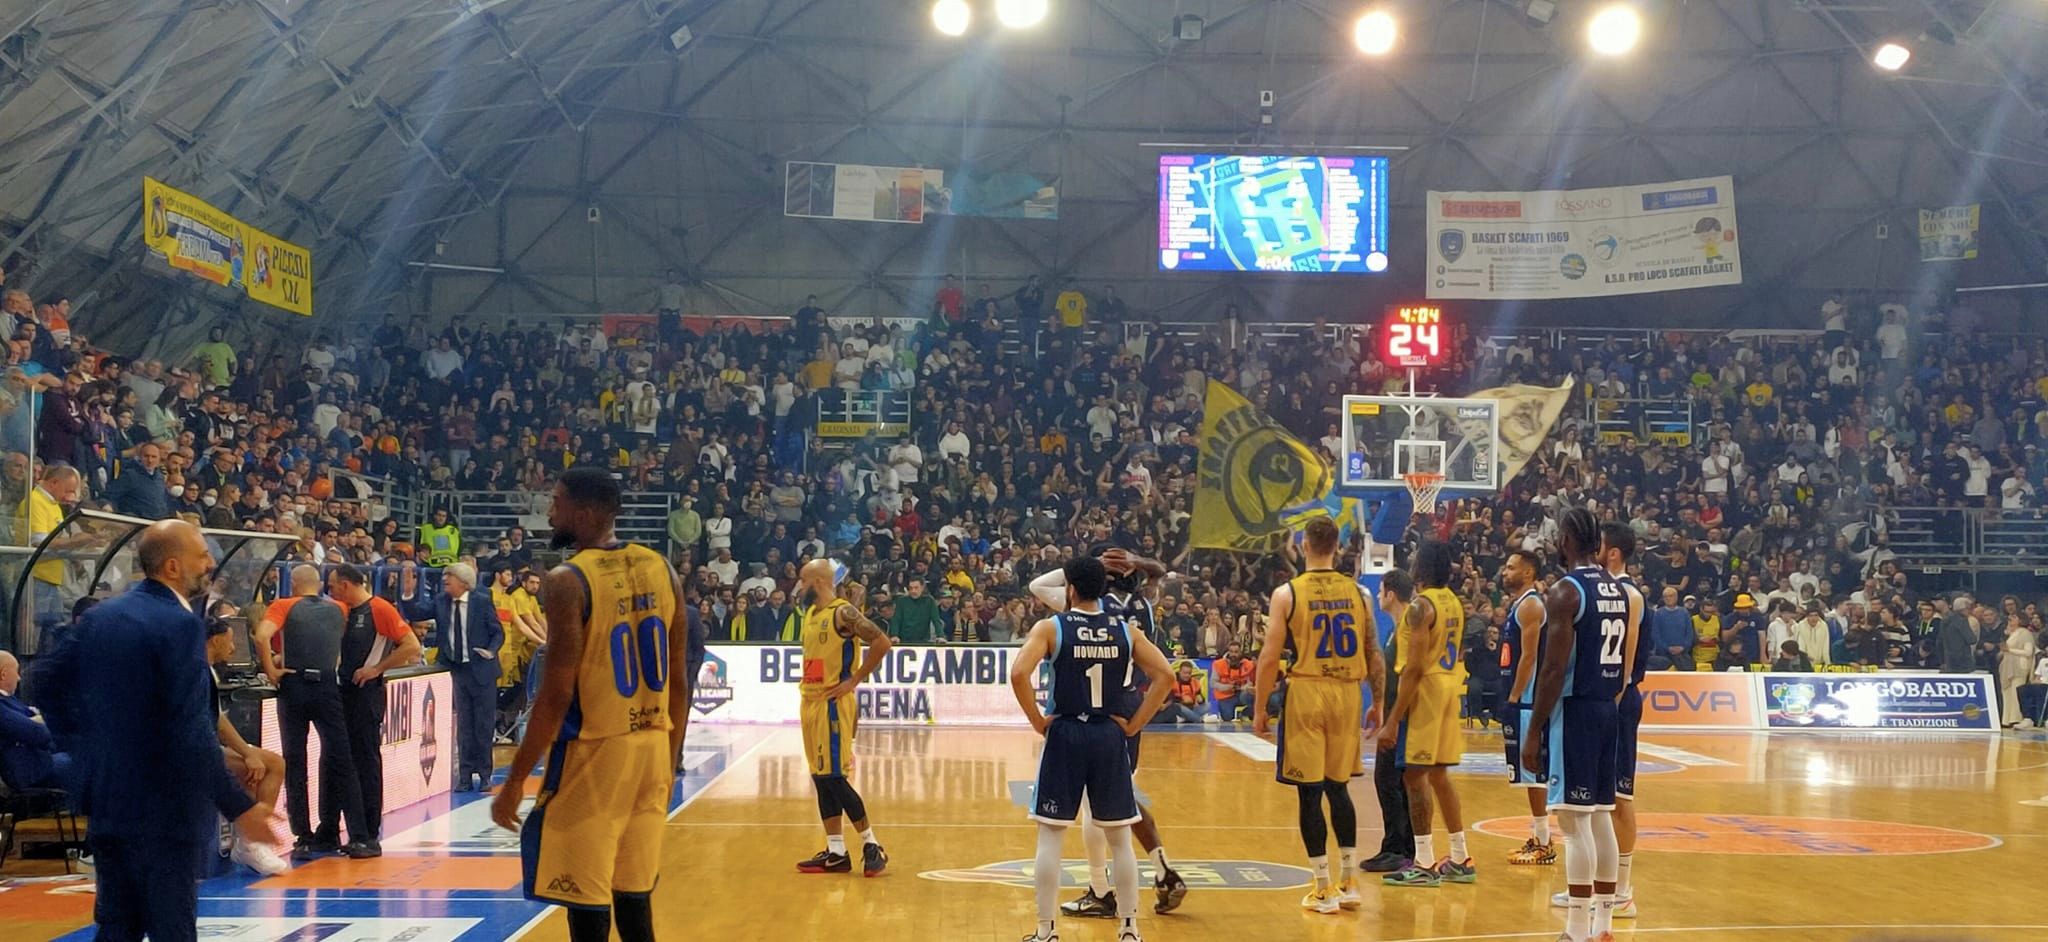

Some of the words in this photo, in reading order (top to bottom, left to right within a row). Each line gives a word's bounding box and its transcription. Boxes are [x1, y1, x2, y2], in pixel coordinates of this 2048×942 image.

[1472, 231, 1506, 243] BASKET
[1546, 231, 1569, 242] 1969
[1628, 270, 1645, 282] PRO
[1702, 262, 1734, 275] BASKET
[1400, 308, 1439, 323] 4:04
[1389, 324, 1439, 356] 24
[1073, 645, 1119, 658] HOWARD
[1312, 613, 1358, 659] 26
[1439, 630, 1457, 671] 5
[1600, 618, 1626, 665] 22
[610, 615, 667, 698] 00
[862, 648, 1008, 684] RICAMBI
[1085, 663, 1103, 708] 1
[857, 687, 931, 720] RENA
[1890, 718, 1959, 727] TRADIZIONE
